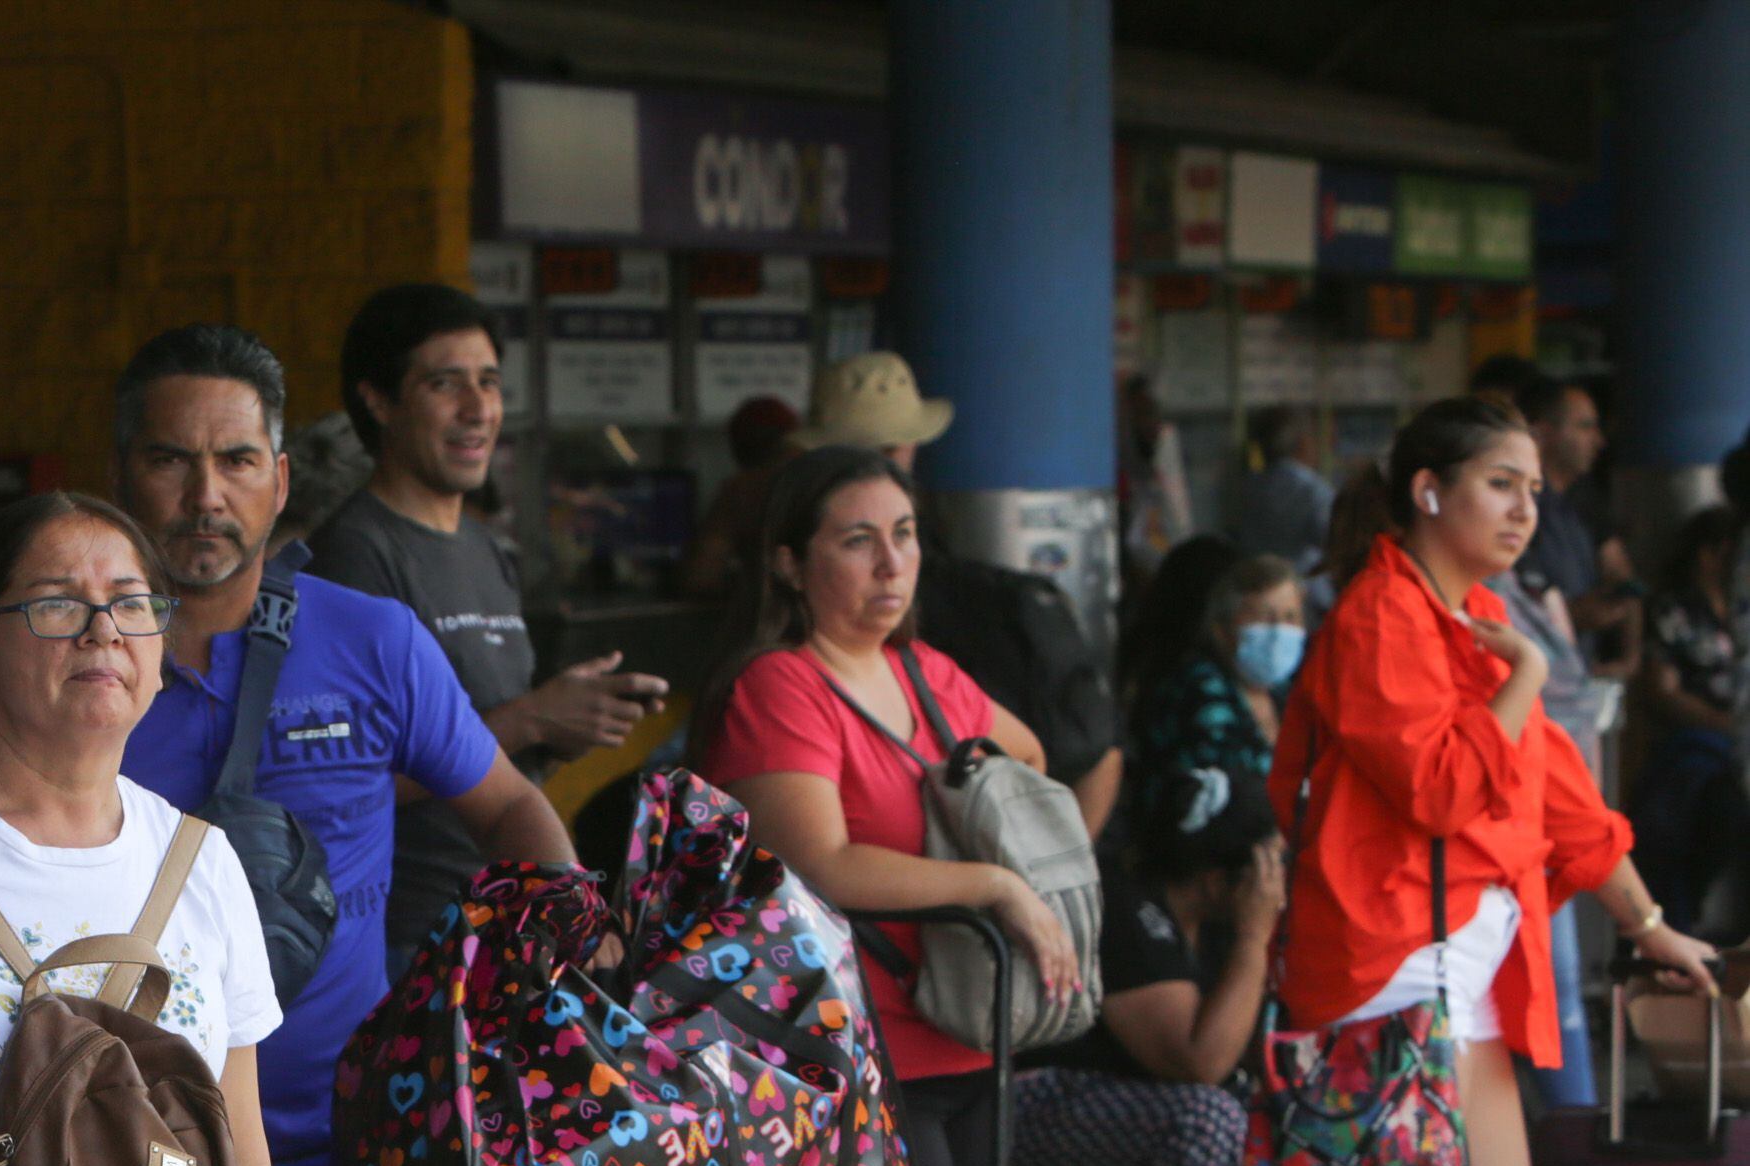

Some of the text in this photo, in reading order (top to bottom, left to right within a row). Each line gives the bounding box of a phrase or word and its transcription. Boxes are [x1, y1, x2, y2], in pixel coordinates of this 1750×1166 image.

[693, 132, 849, 236] CONDOR
[266, 698, 400, 765] EANS
[761, 1094, 833, 1159] OVE
